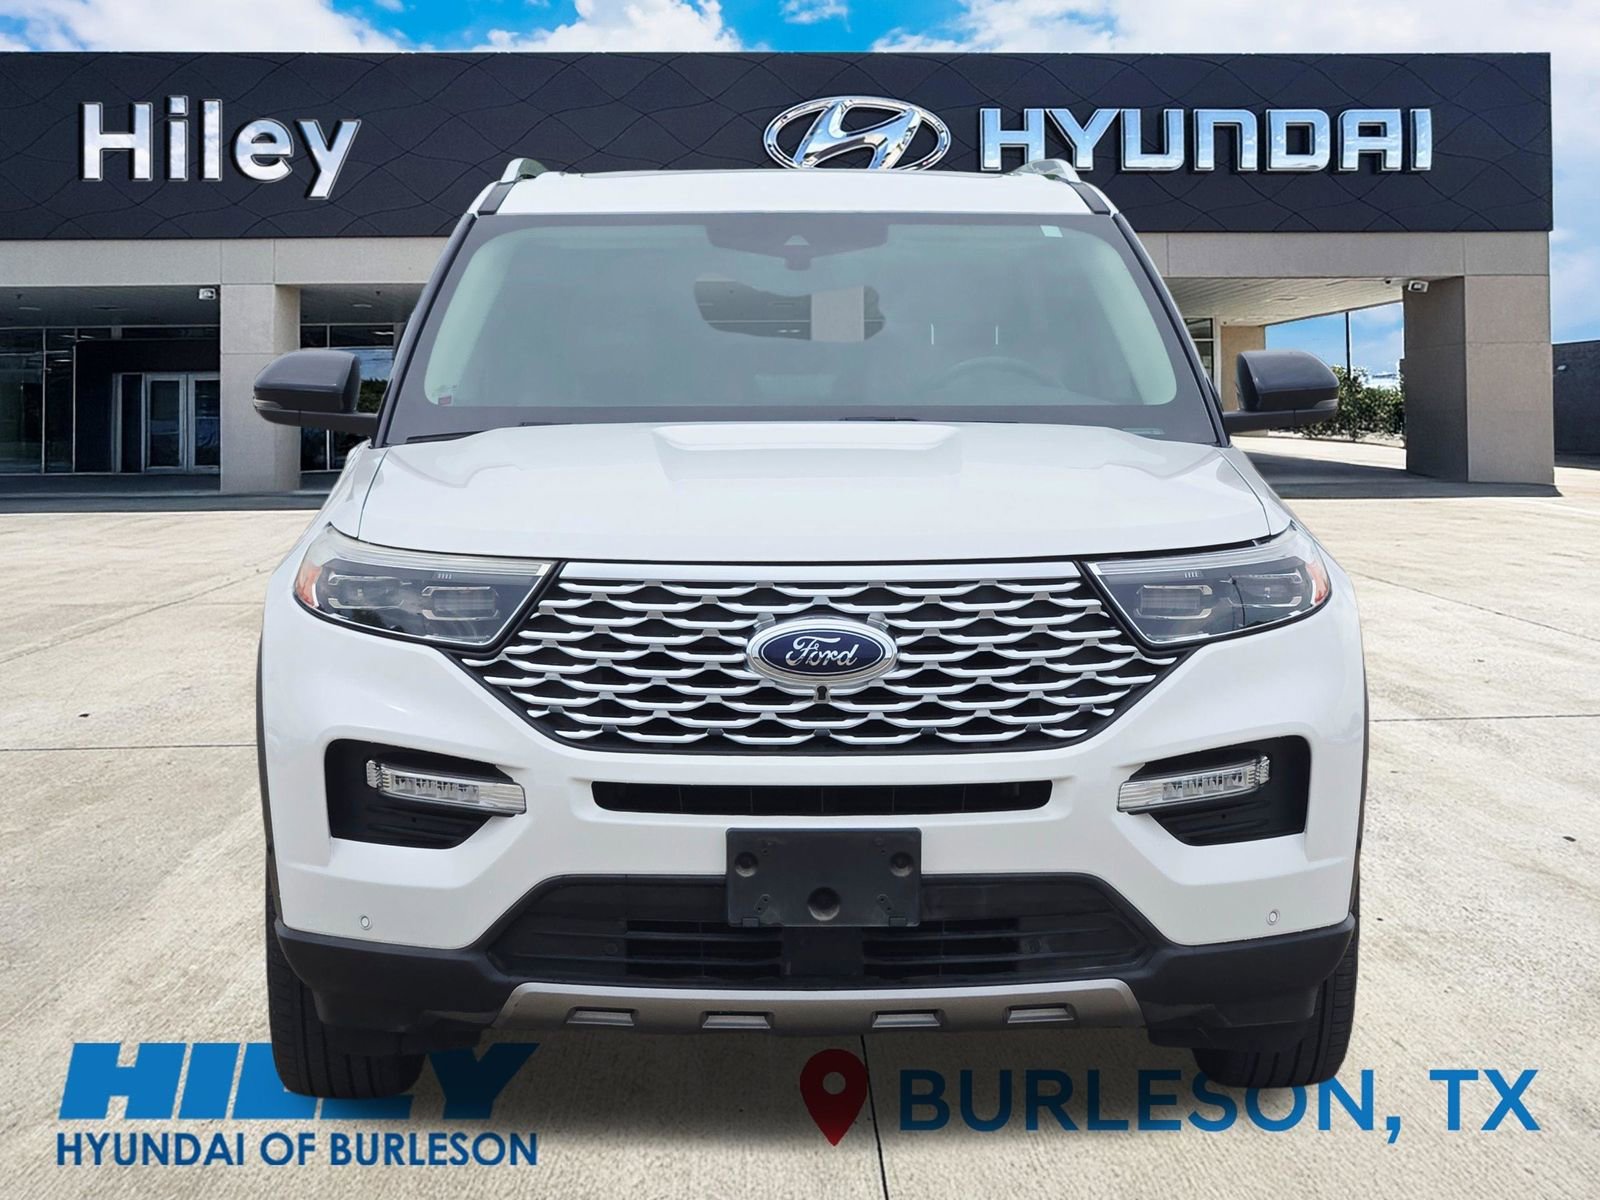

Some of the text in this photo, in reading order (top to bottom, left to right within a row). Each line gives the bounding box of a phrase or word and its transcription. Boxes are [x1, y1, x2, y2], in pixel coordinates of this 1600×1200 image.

[80, 95, 361, 199] Hiley
[979, 108, 1433, 172] HYUNDAI
[785, 635, 859, 666] Ford
